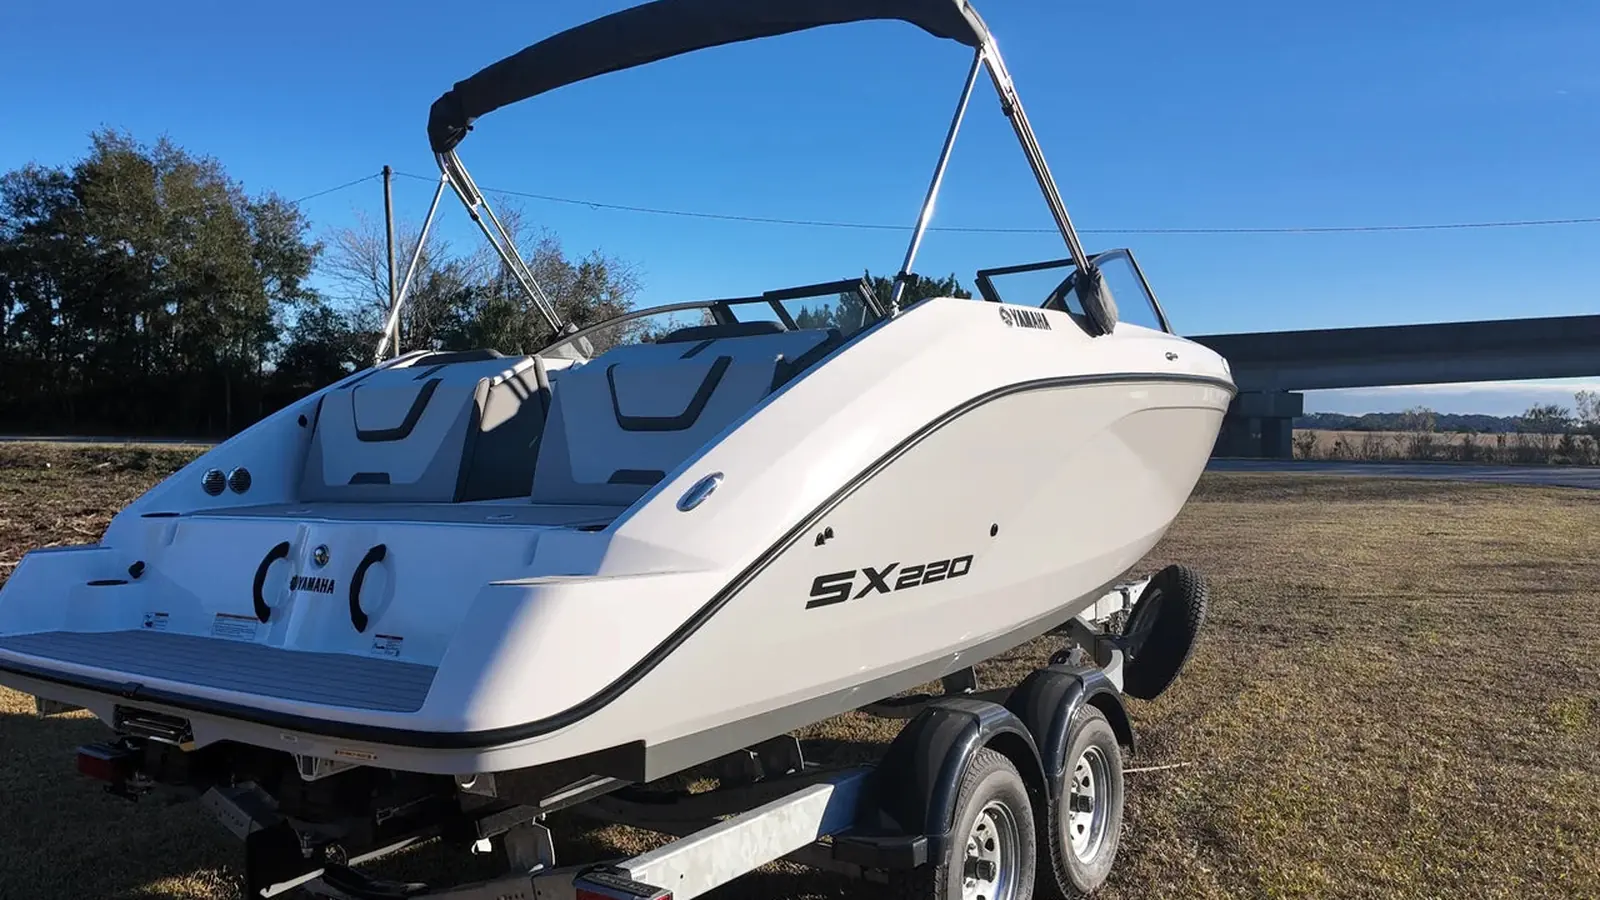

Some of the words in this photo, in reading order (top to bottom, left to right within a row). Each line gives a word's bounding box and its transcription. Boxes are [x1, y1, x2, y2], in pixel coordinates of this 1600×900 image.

[1009, 308, 1052, 331] YAMAHA
[297, 576, 335, 595] YAMAHA
[805, 554, 974, 610] SX220
